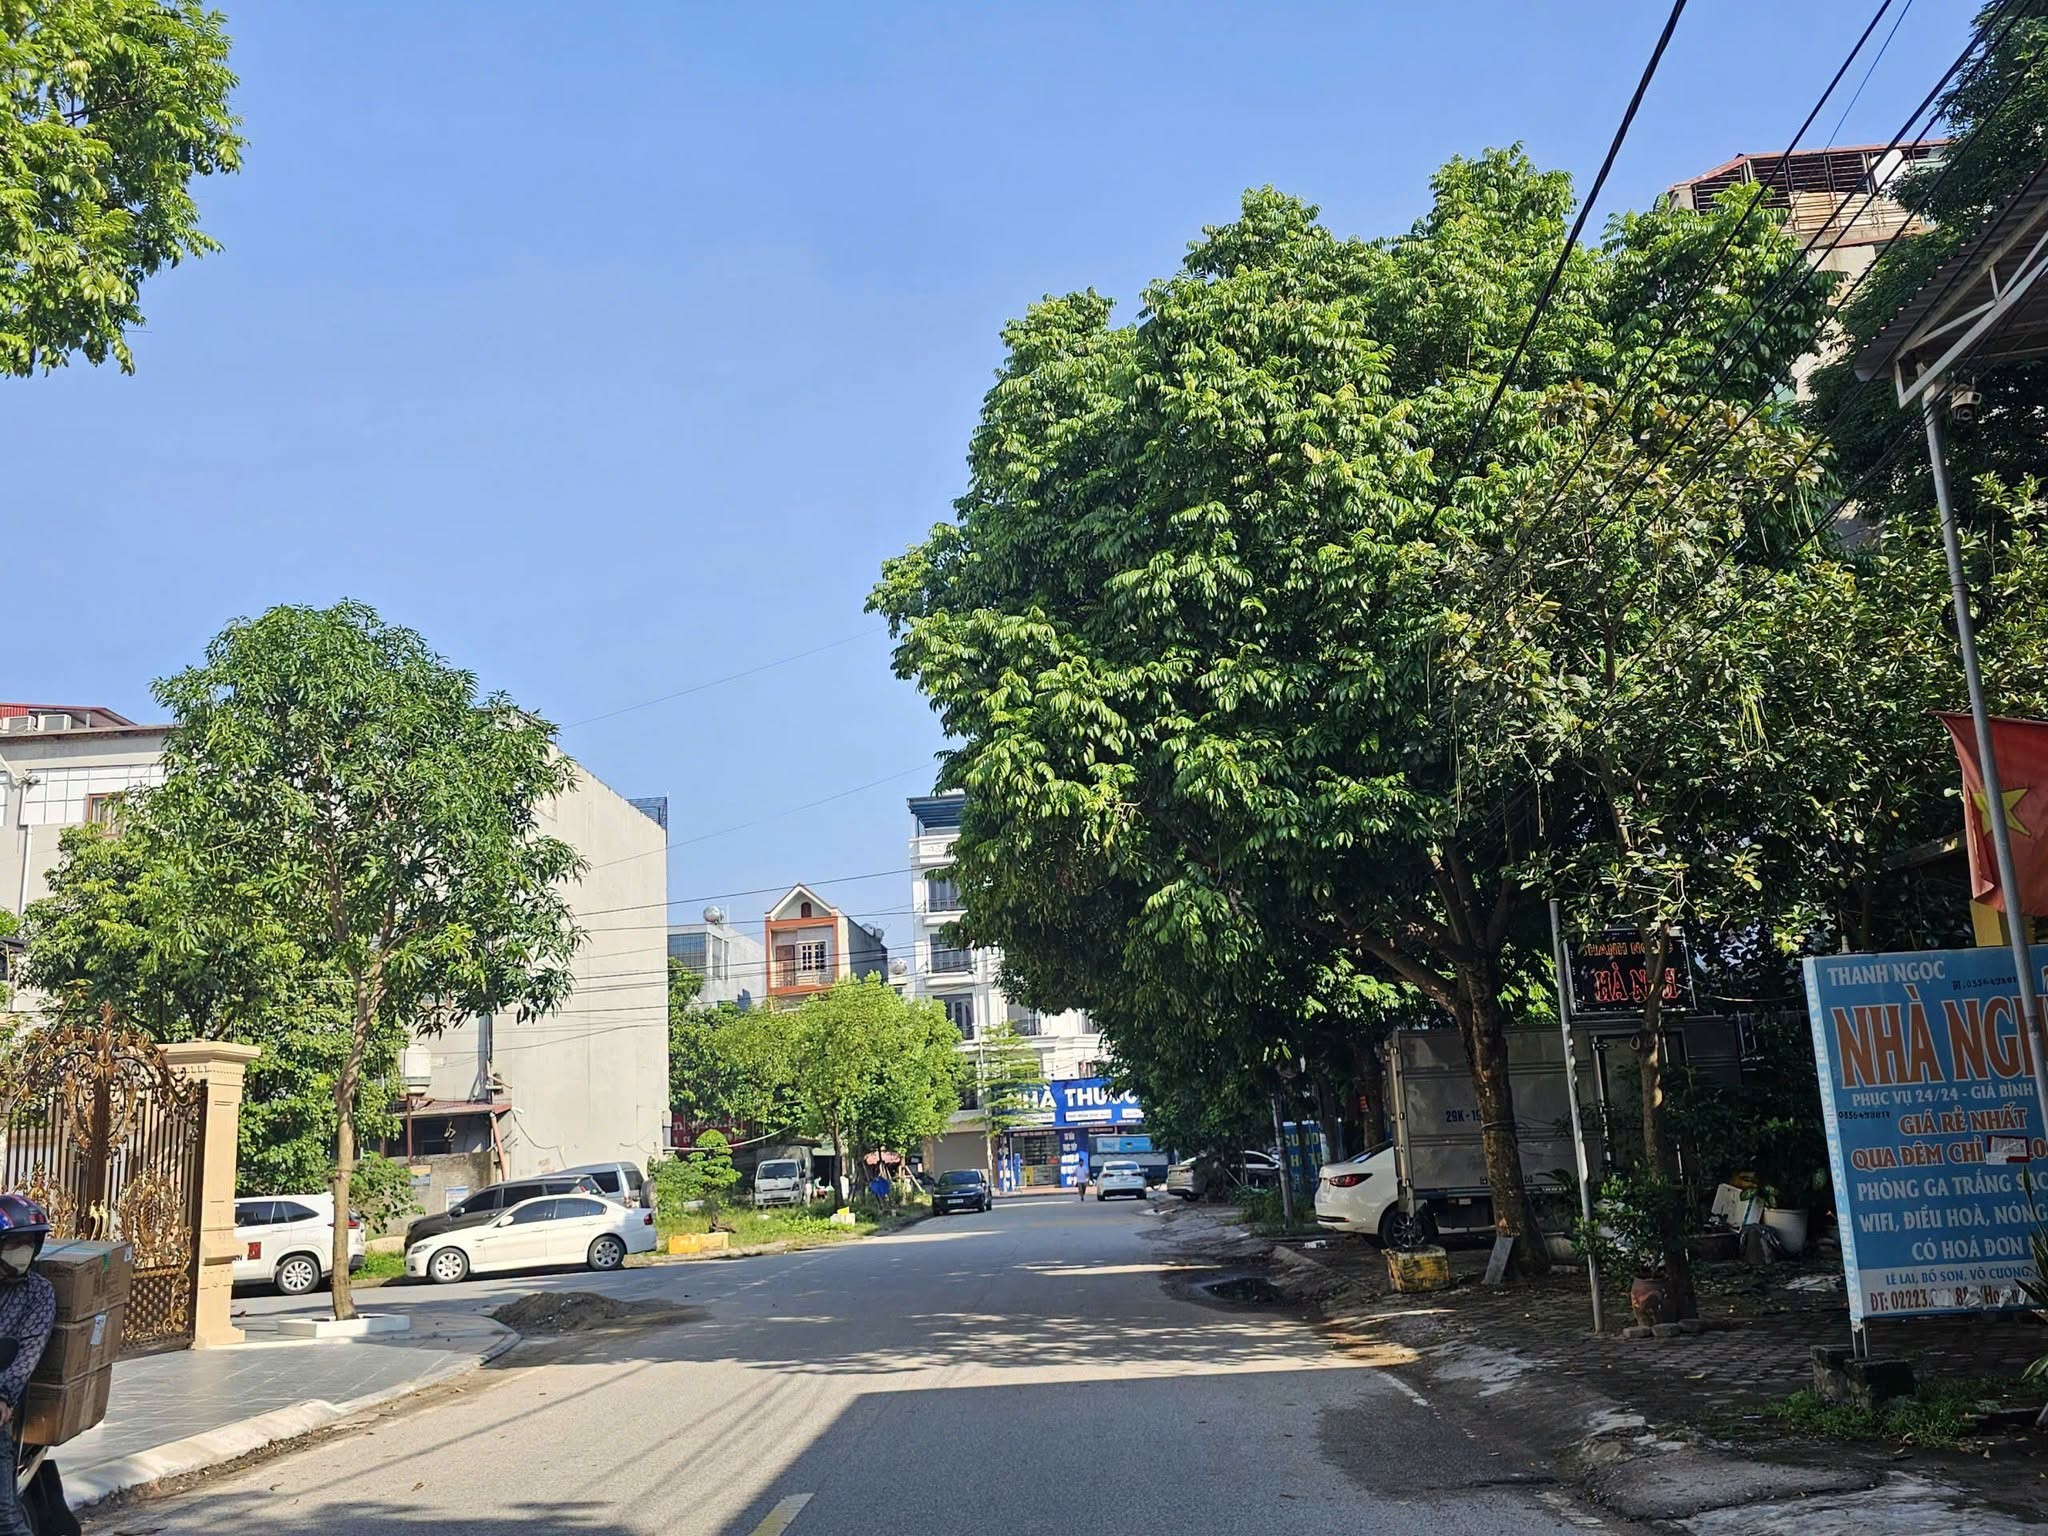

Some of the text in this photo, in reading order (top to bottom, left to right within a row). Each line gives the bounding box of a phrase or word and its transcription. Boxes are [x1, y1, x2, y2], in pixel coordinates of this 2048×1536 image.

[1827, 960, 1946, 986] THANH NGỌC
[1830, 982, 1946, 1089] NHÀ
[1852, 1091, 1890, 1108] PHỤC
[1892, 1089, 1913, 1106] VỤ
[1915, 1087, 1958, 1102] 24/24
[1970, 1082, 1997, 1099] GIÁ
[2000, 1081, 2034, 1098] BÌNH
[1898, 1101, 2028, 1136] GIÁ RẺ NHẤT
[1851, 1147, 1899, 1173] QUA
[1898, 1140, 1945, 1167] ĐÊM
[1947, 1135, 1986, 1165] CHỈ
[1857, 1177, 1920, 1202] PHÒNG
[1923, 1178, 1950, 1197] GA
[1952, 1168, 2012, 1195] TRẮNG
[1858, 1200, 2048, 1233] WIFI, ĐIỀU HOÀ, NÓNG
[1911, 1237, 1938, 1261] CÓ
[1941, 1234, 1981, 1259] HOÁ
[1983, 1235, 2024, 1257] ĐƠN
[1870, 1291, 1889, 1312] ĐT:
